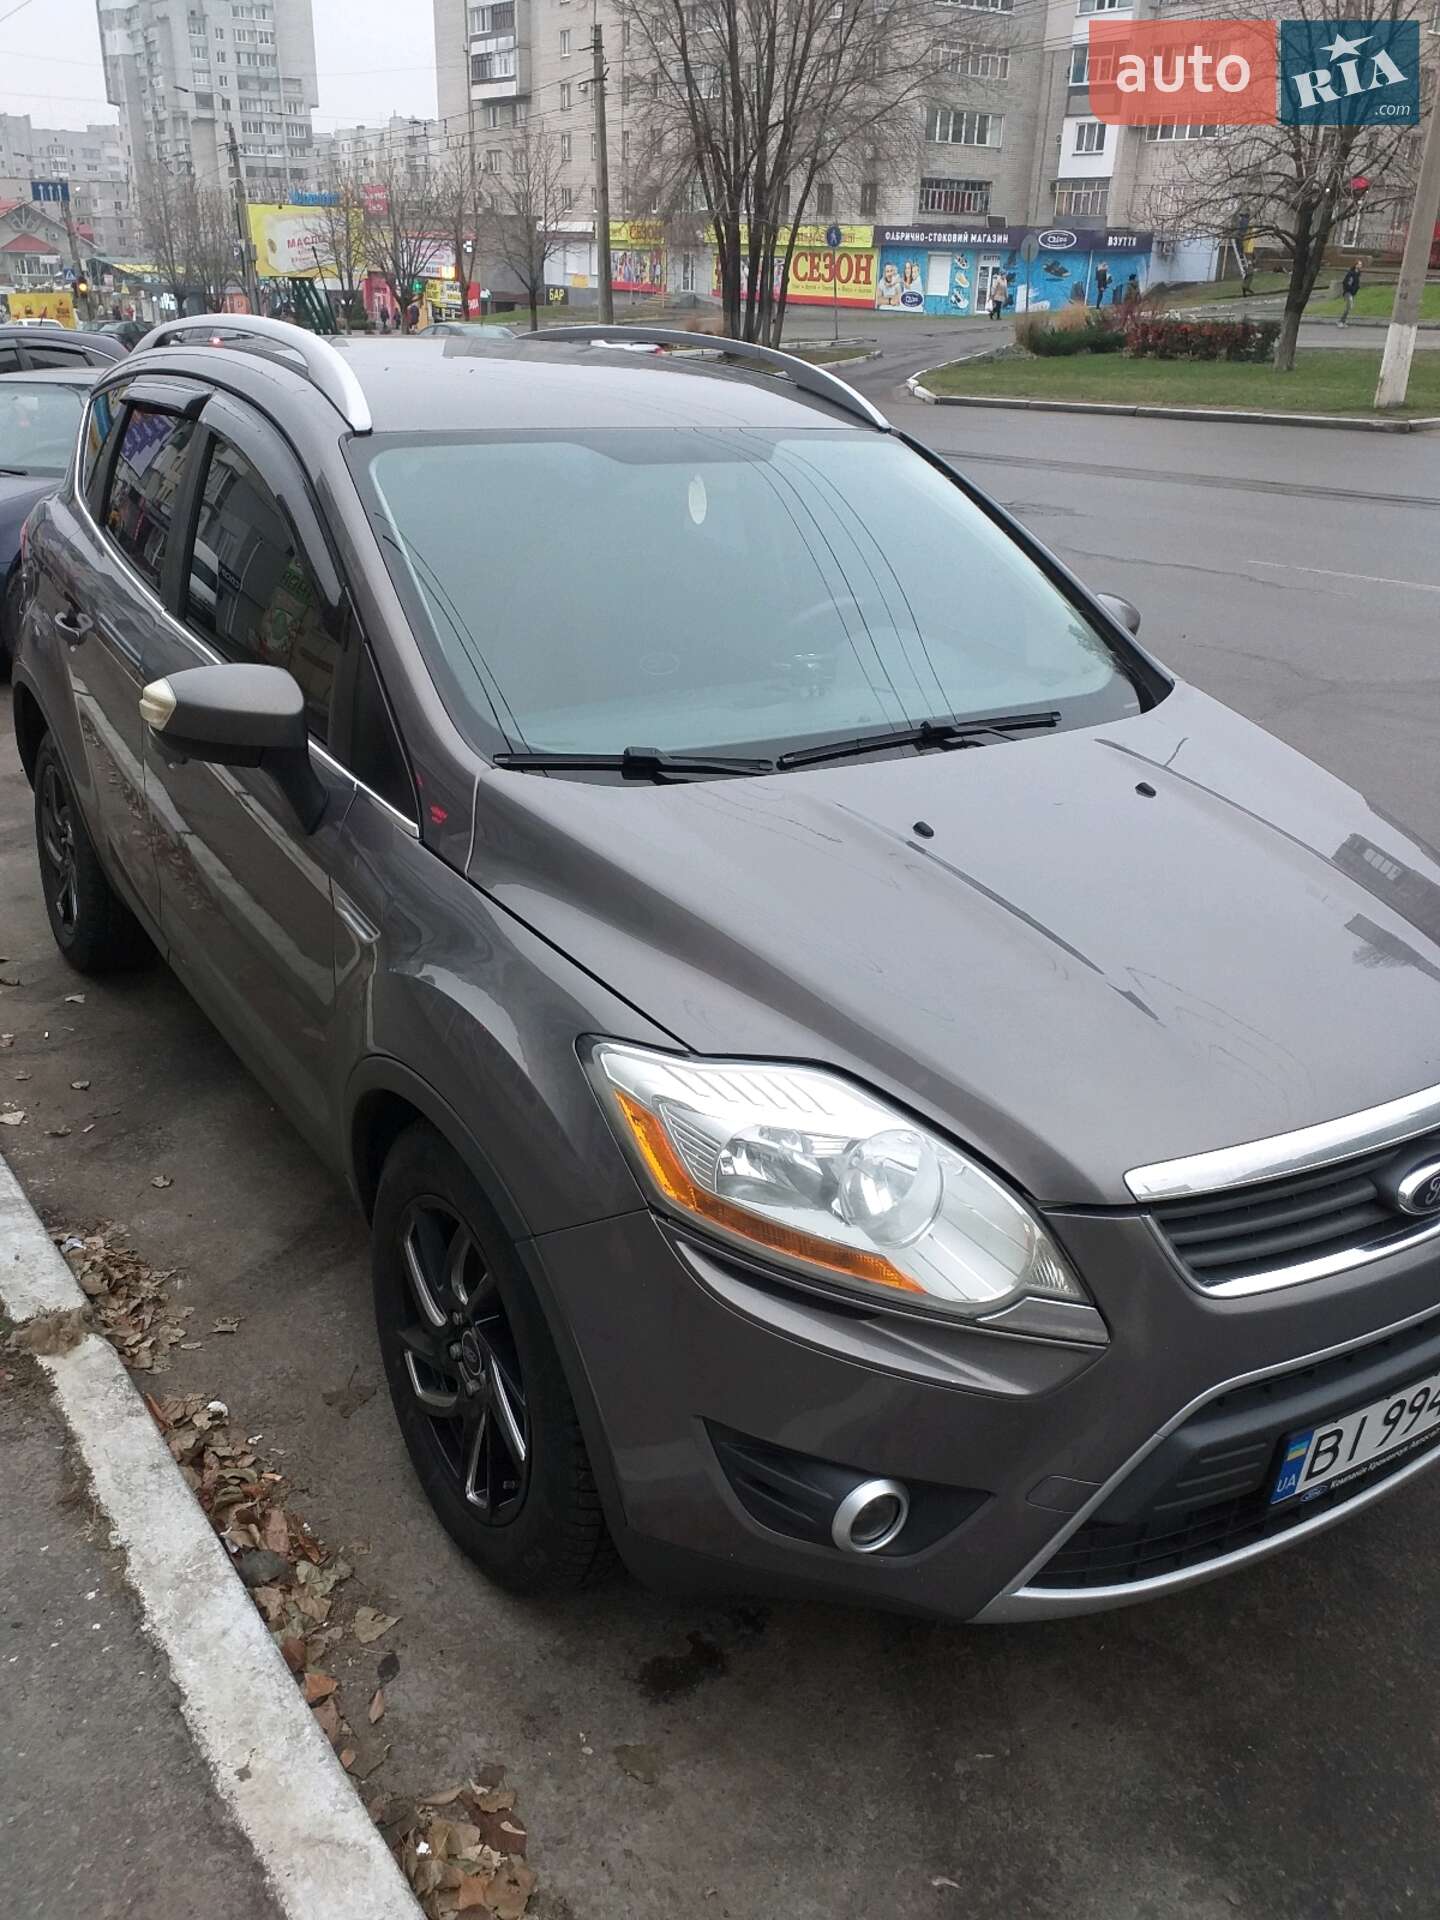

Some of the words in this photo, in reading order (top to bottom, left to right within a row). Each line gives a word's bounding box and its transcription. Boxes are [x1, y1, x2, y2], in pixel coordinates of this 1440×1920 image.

[885, 231, 968, 243] ФАБРИЧНО-СТОКОВИЙ
[970, 233, 1009, 244] МАГАЗИН
[1107, 236, 1137, 247] ВЗУТТЯ
[793, 251, 874, 285] СЕЗОН
[549, 288, 565, 301] БАР
[1276, 1474, 1296, 1493] UA
